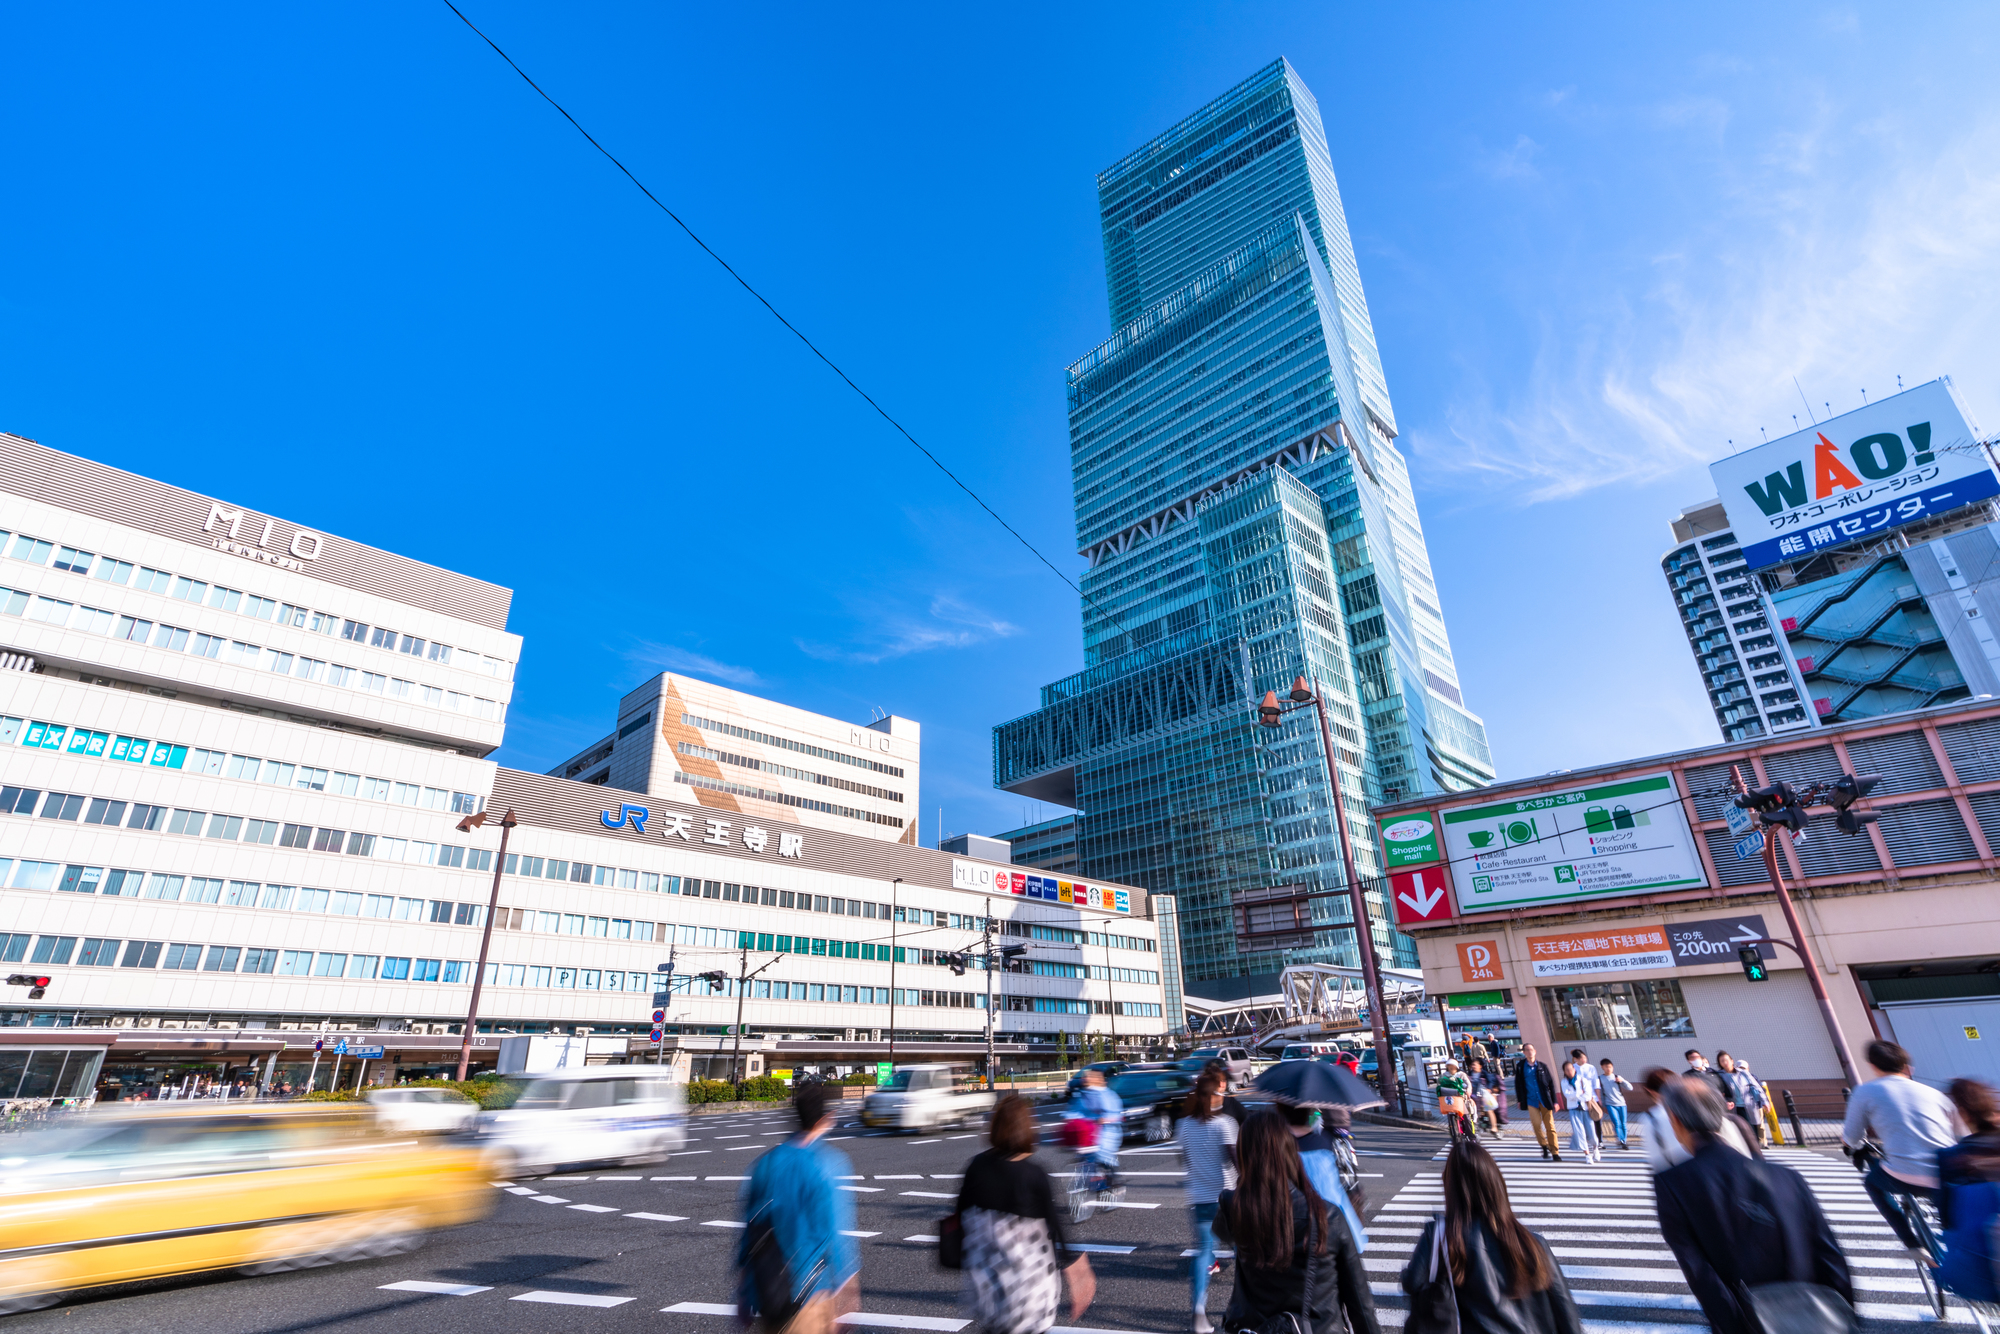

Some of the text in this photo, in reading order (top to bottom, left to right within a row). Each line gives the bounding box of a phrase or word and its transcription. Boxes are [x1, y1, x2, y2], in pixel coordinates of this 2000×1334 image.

[1743, 421, 1936, 517] WAO!
[1769, 466, 1940, 530] ワオ・コーポレーション
[1778, 492, 1954, 556] 能開センター
[203, 503, 324, 562] MIO
[27, 727, 168, 763] EXPRESS
[850, 727, 890, 753] MIO
[1556, 792, 1587, 804] ご案内
[600, 803, 803, 859] JR 天王寺駅
[1595, 832, 1633, 843] ショッピング
[1392, 844, 1432, 855] Shopping
[1597, 842, 1638, 854] Shopping
[1404, 852, 1422, 861] mall
[955, 864, 989, 885] MIO
[1589, 867, 1610, 876] Tennoji
[1518, 877, 1538, 885] Tennoji
[1583, 881, 1609, 890] Kintetsu
[1103, 891, 1115, 901] ABC
[1673, 931, 1704, 942] この先
[1533, 932, 1663, 954] 天王寺公園地下駐車場
[1676, 939, 1731, 957] 200m
[1466, 945, 1490, 968] P
[559, 971, 641, 989] PLST
[1471, 969, 1493, 979] 24h
[311, 1035, 366, 1045] 天王寺駅
[473, 1038, 487, 1046] IO
